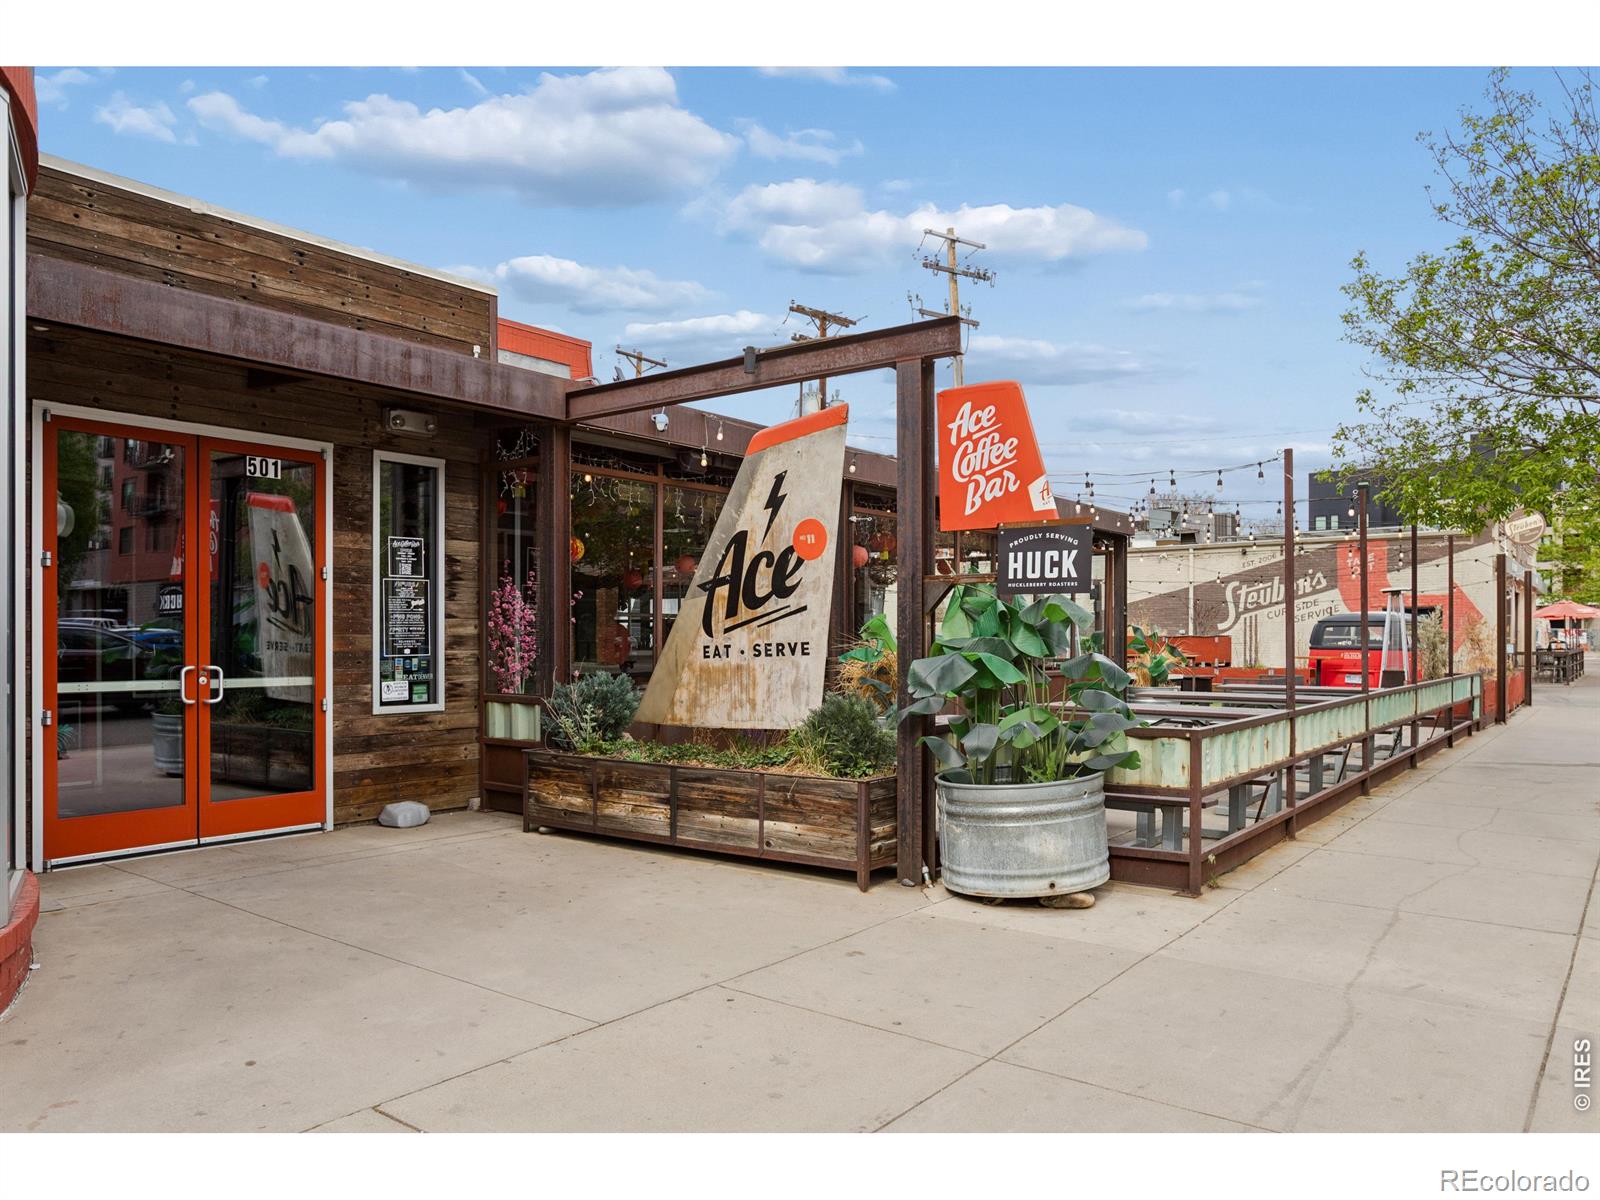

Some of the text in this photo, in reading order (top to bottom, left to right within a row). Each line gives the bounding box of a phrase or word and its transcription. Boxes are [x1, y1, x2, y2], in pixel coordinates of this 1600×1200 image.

[947, 402, 996, 446] Ace
[247, 456, 280, 479] 501
[952, 432, 1019, 483] Coffee
[965, 469, 1020, 516] Bar
[1009, 532, 1079, 548] PROUDLY SERVING
[1008, 549, 1079, 580] HUCK
[1346, 552, 1375, 567] TAE
[1352, 561, 1375, 575] OT
[696, 529, 806, 639] Ace
[1216, 570, 1328, 630] Steubn's
[703, 641, 811, 659] EAT SERVE
